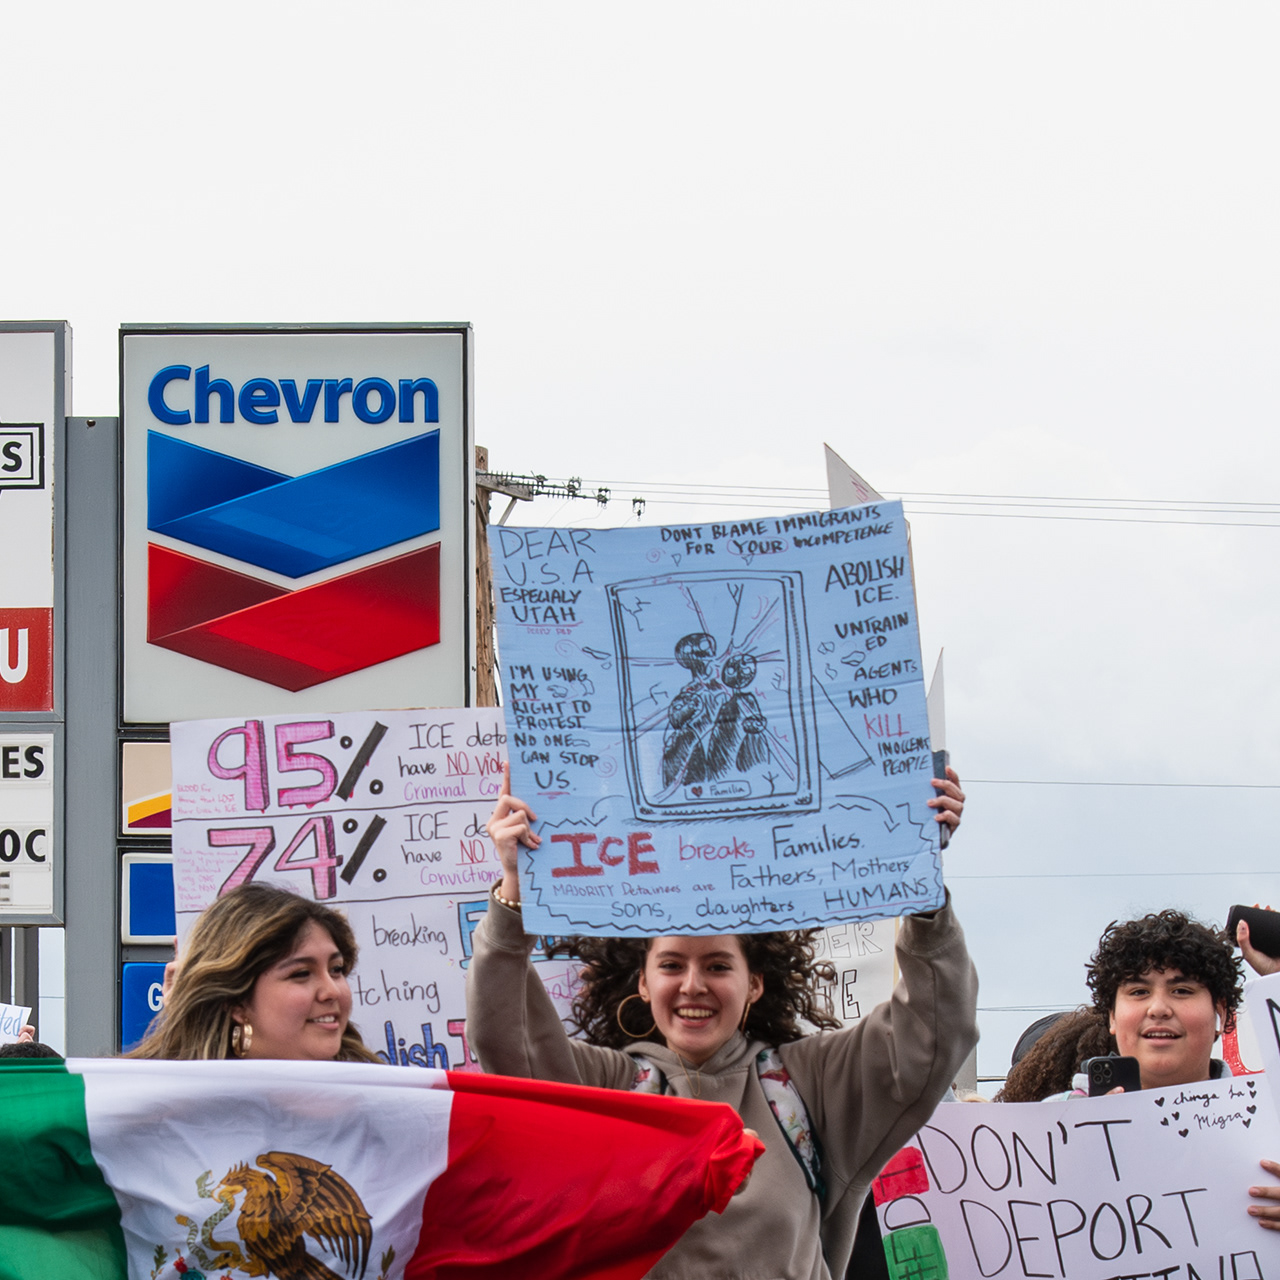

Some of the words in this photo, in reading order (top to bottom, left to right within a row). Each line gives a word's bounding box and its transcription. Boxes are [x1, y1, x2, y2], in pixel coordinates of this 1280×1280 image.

[147, 363, 440, 425] Chevron
[661, 527, 703, 543] DONT
[712, 520, 768, 539] BLAME
[775, 505, 882, 534] IMMIGRANTS
[499, 529, 596, 559] DEAR
[686, 542, 715, 555] FOR
[731, 539, 784, 554] YOUR
[503, 559, 595, 586] U.S.A
[825, 555, 905, 593] ABOLISH
[511, 605, 576, 624] UTAH
[834, 612, 909, 639] UNTRAIN
[865, 635, 888, 651] ED
[509, 665, 535, 680] I'M
[542, 667, 588, 682] USING
[854, 659, 918, 681] AGENTS
[510, 683, 538, 699] MY
[848, 687, 898, 708] WHO
[512, 701, 566, 717] RIGHT
[572, 700, 592, 714] TO
[864, 713, 910, 739] KILL
[514, 732, 537, 747] NO
[544, 734, 574, 747] ONE
[207, 719, 389, 813] 95%
[409, 722, 455, 750] ICE
[398, 756, 437, 777] have
[446, 751, 470, 776] NO
[521, 751, 550, 764] CAN
[560, 751, 599, 768] STOP
[882, 754, 932, 776] PEOPLE
[404, 777, 467, 801] Criminal
[404, 811, 450, 841] ICE
[401, 845, 442, 864] have
[460, 839, 485, 864] NO
[550, 831, 660, 878] ICE
[679, 835, 755, 862] breaks
[772, 824, 865, 861] Families.
[420, 866, 504, 886] Convictions
[553, 884, 614, 897] MAJORITY
[692, 883, 716, 892] are
[831, 850, 911, 882] Mothers
[372, 913, 448, 955] breaking
[916, 1119, 1132, 1193] DON'T
[961, 1187, 1207, 1278] DEPORT
